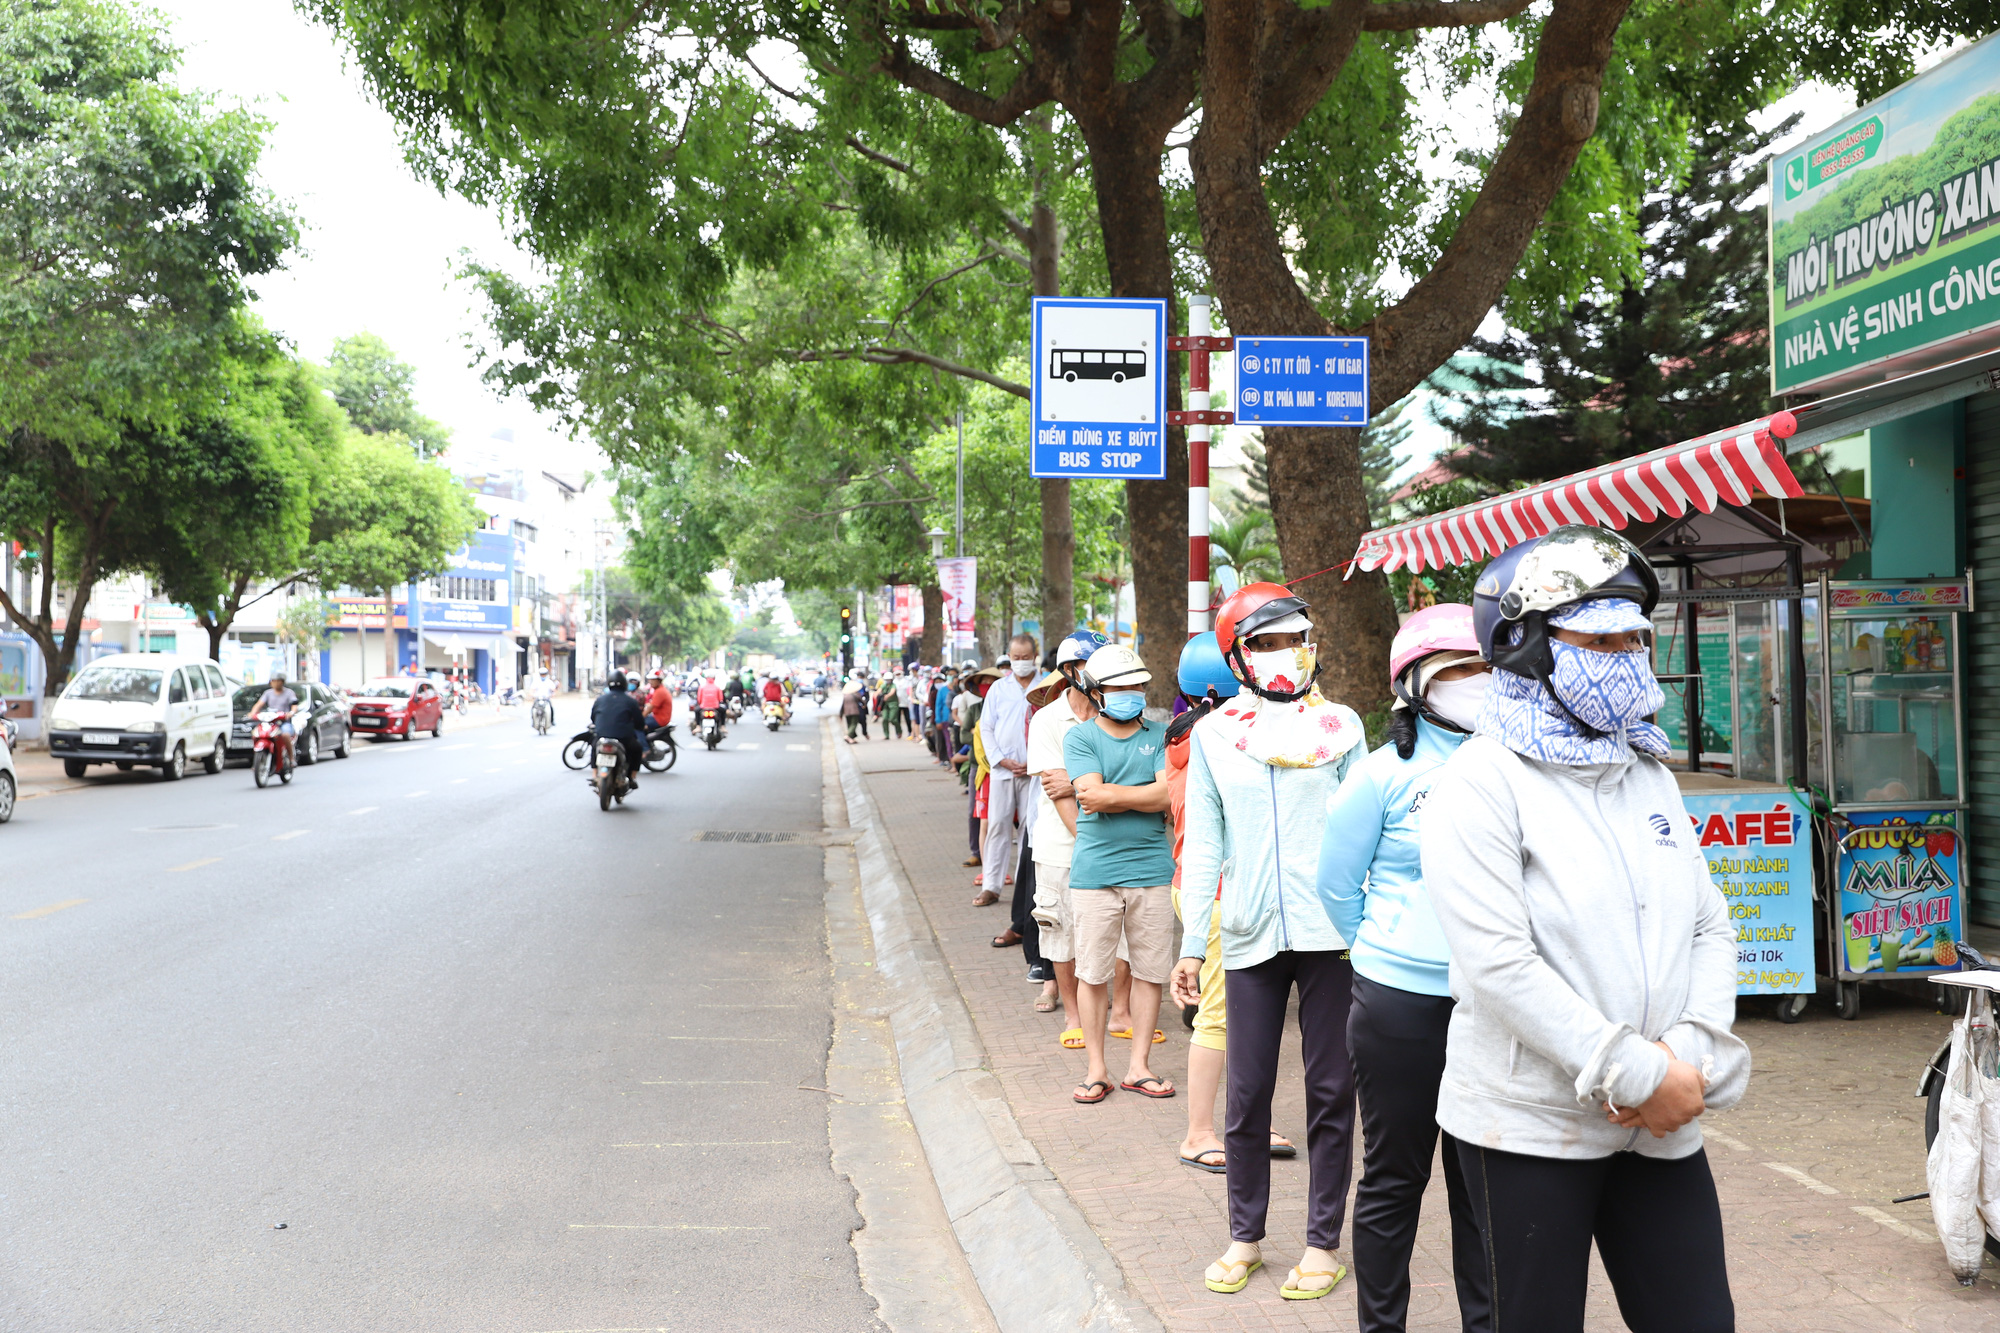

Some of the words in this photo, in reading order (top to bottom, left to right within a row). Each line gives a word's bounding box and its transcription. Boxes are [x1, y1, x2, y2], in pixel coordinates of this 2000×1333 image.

[1861, 122, 1876, 141] CÁO
[1786, 235, 1828, 301] MÔI
[1834, 191, 1936, 280] TRƯỜNG
[1784, 319, 1829, 369] NHÀ
[1829, 304, 1860, 354] VỆ
[1863, 288, 1924, 341] SINH
[1928, 258, 2000, 317] CÔNG
[1245, 359, 1258, 370] 06
[1263, 357, 1270, 374] C
[1271, 358, 1281, 374] TY
[1284, 358, 1294, 374] VT
[1244, 391, 1257, 402] 09
[1263, 390, 1274, 407] BX
[1276, 387, 1295, 407] PHÍA
[1296, 391, 1315, 407] NAM
[1326, 391, 1363, 408] KOREVINA
[1038, 424, 1066, 445] ĐIỂM
[1072, 426, 1103, 446] DỪNG
[1107, 431, 1122, 446] XE
[1128, 427, 1158, 447] BÚYT
[1058, 451, 1091, 468] BUS
[1101, 452, 1142, 468] STOP
[1655, 837, 1678, 849] adidas
[1847, 816, 1927, 850] NƯỚC
[1708, 857, 1741, 878] ĐẬU
[1743, 855, 1789, 874] NÀNH
[1844, 854, 1955, 895] MÍA
[1745, 881, 1789, 896] XANH
[1851, 899, 1897, 939] SIÊU
[1899, 895, 1952, 938] SẠCH
[1734, 924, 1753, 942] ẢI
[1756, 923, 1796, 942] KHÁT
[1761, 949, 1784, 963] 10k
[1759, 968, 1805, 988] Ngày
